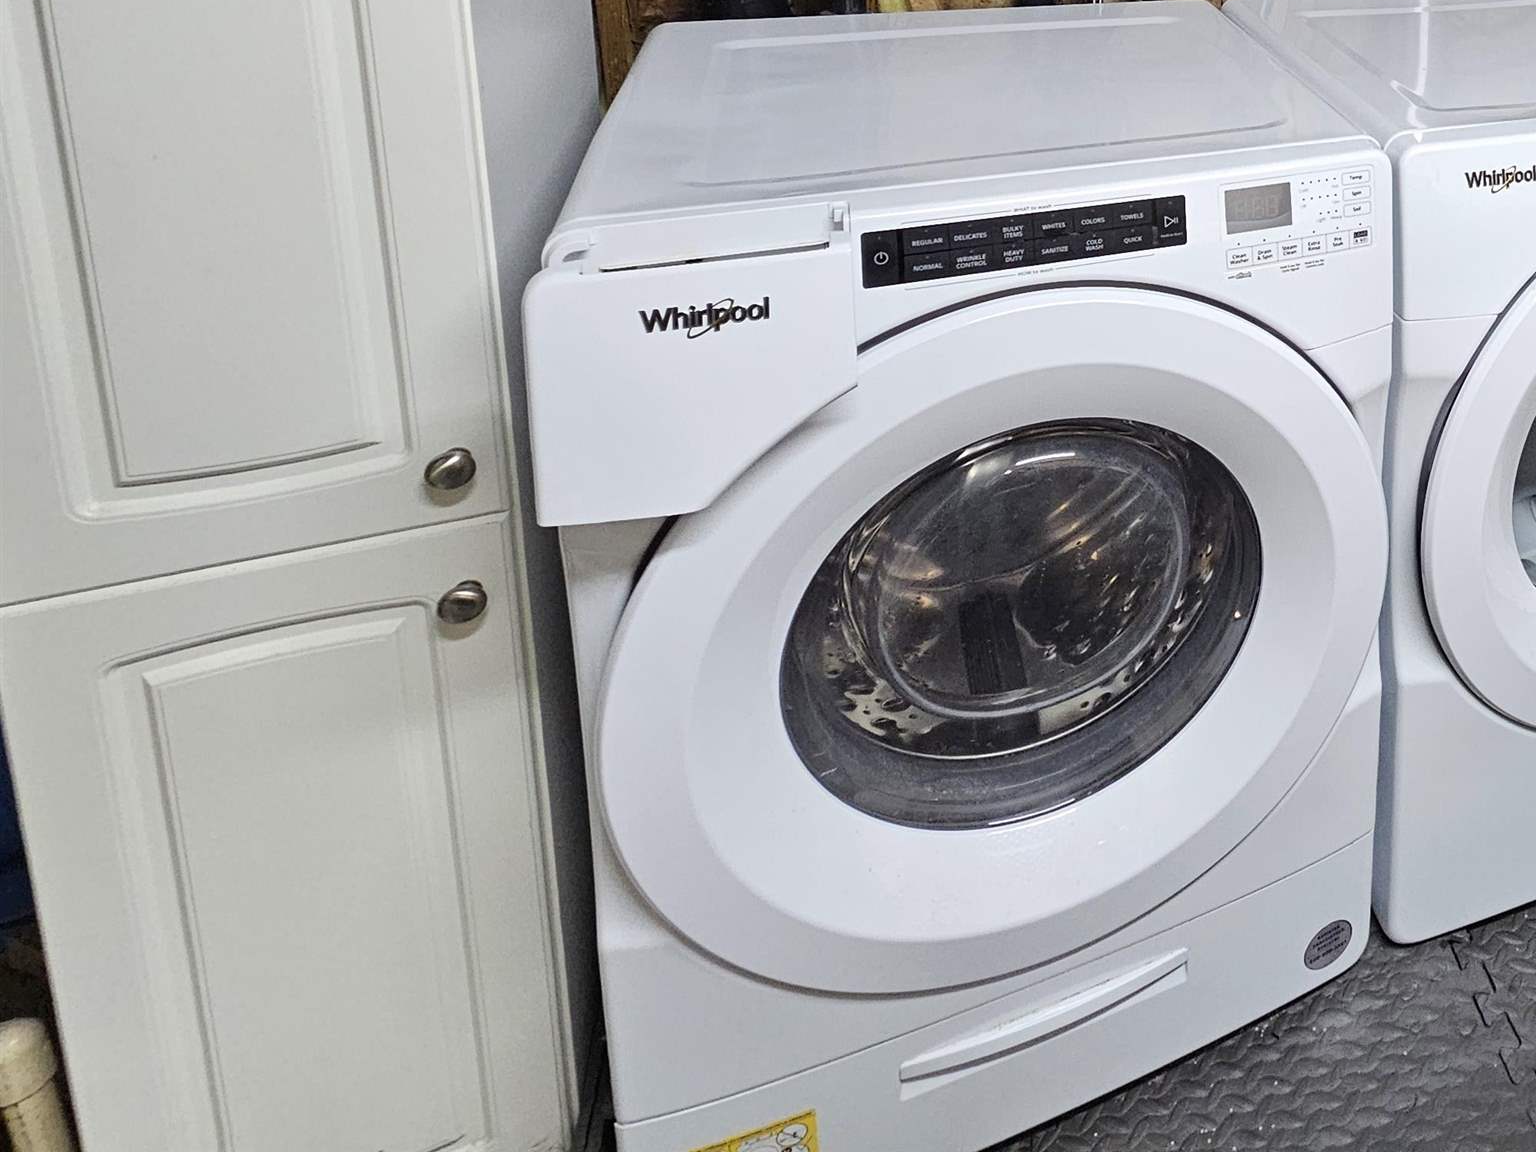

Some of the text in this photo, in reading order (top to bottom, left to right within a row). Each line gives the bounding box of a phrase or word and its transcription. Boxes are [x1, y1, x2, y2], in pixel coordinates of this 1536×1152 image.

[1464, 165, 1536, 193] Whirlpool
[1080, 216, 1106, 226] COLORS
[1119, 212, 1144, 221] TOWELS
[1001, 225, 1025, 233] BULKY
[1041, 221, 1066, 230] WHITES
[953, 231, 988, 242] DELICATES
[1003, 231, 1023, 239] ITEMS
[1123, 235, 1143, 244] QUICK
[911, 237, 944, 247] REGULAR
[1085, 238, 1103, 246] COLD
[1003, 248, 1025, 257] HEAVY
[1041, 245, 1069, 255] SANITIZE
[955, 253, 987, 264] WRINKLE
[1004, 255, 1024, 263] DUTY
[912, 262, 944, 273] NORMAL
[955, 260, 988, 270] CONTROL
[638, 296, 770, 339] Whirlpool
